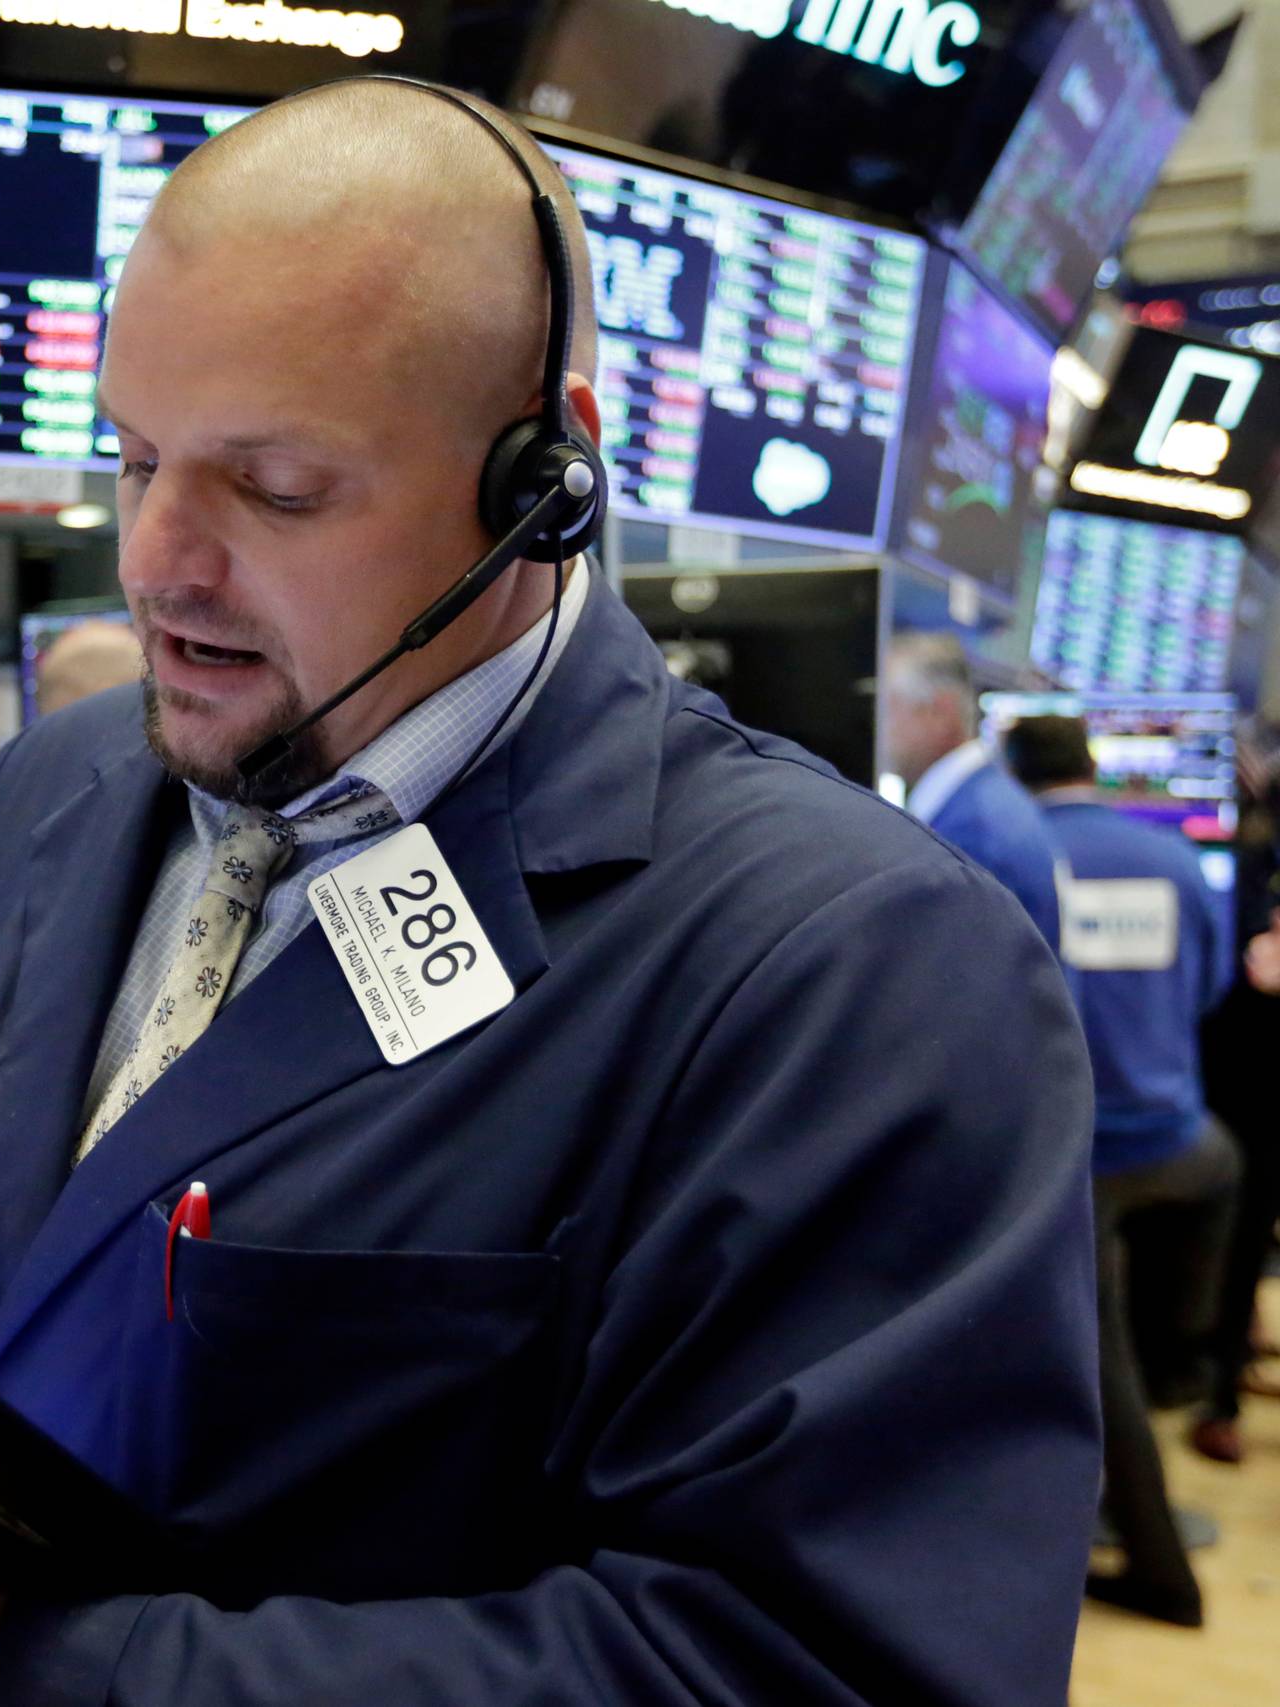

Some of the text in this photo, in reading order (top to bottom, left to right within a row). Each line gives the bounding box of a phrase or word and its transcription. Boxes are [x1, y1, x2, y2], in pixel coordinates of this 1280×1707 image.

[315, 884, 349, 939] LIVERMORE
[343, 939, 372, 985] TRADING
[386, 1031, 404, 1055] INC.
[351, 885, 426, 1017] MICHAEL K. MILANO
[379, 869, 477, 986] 286
